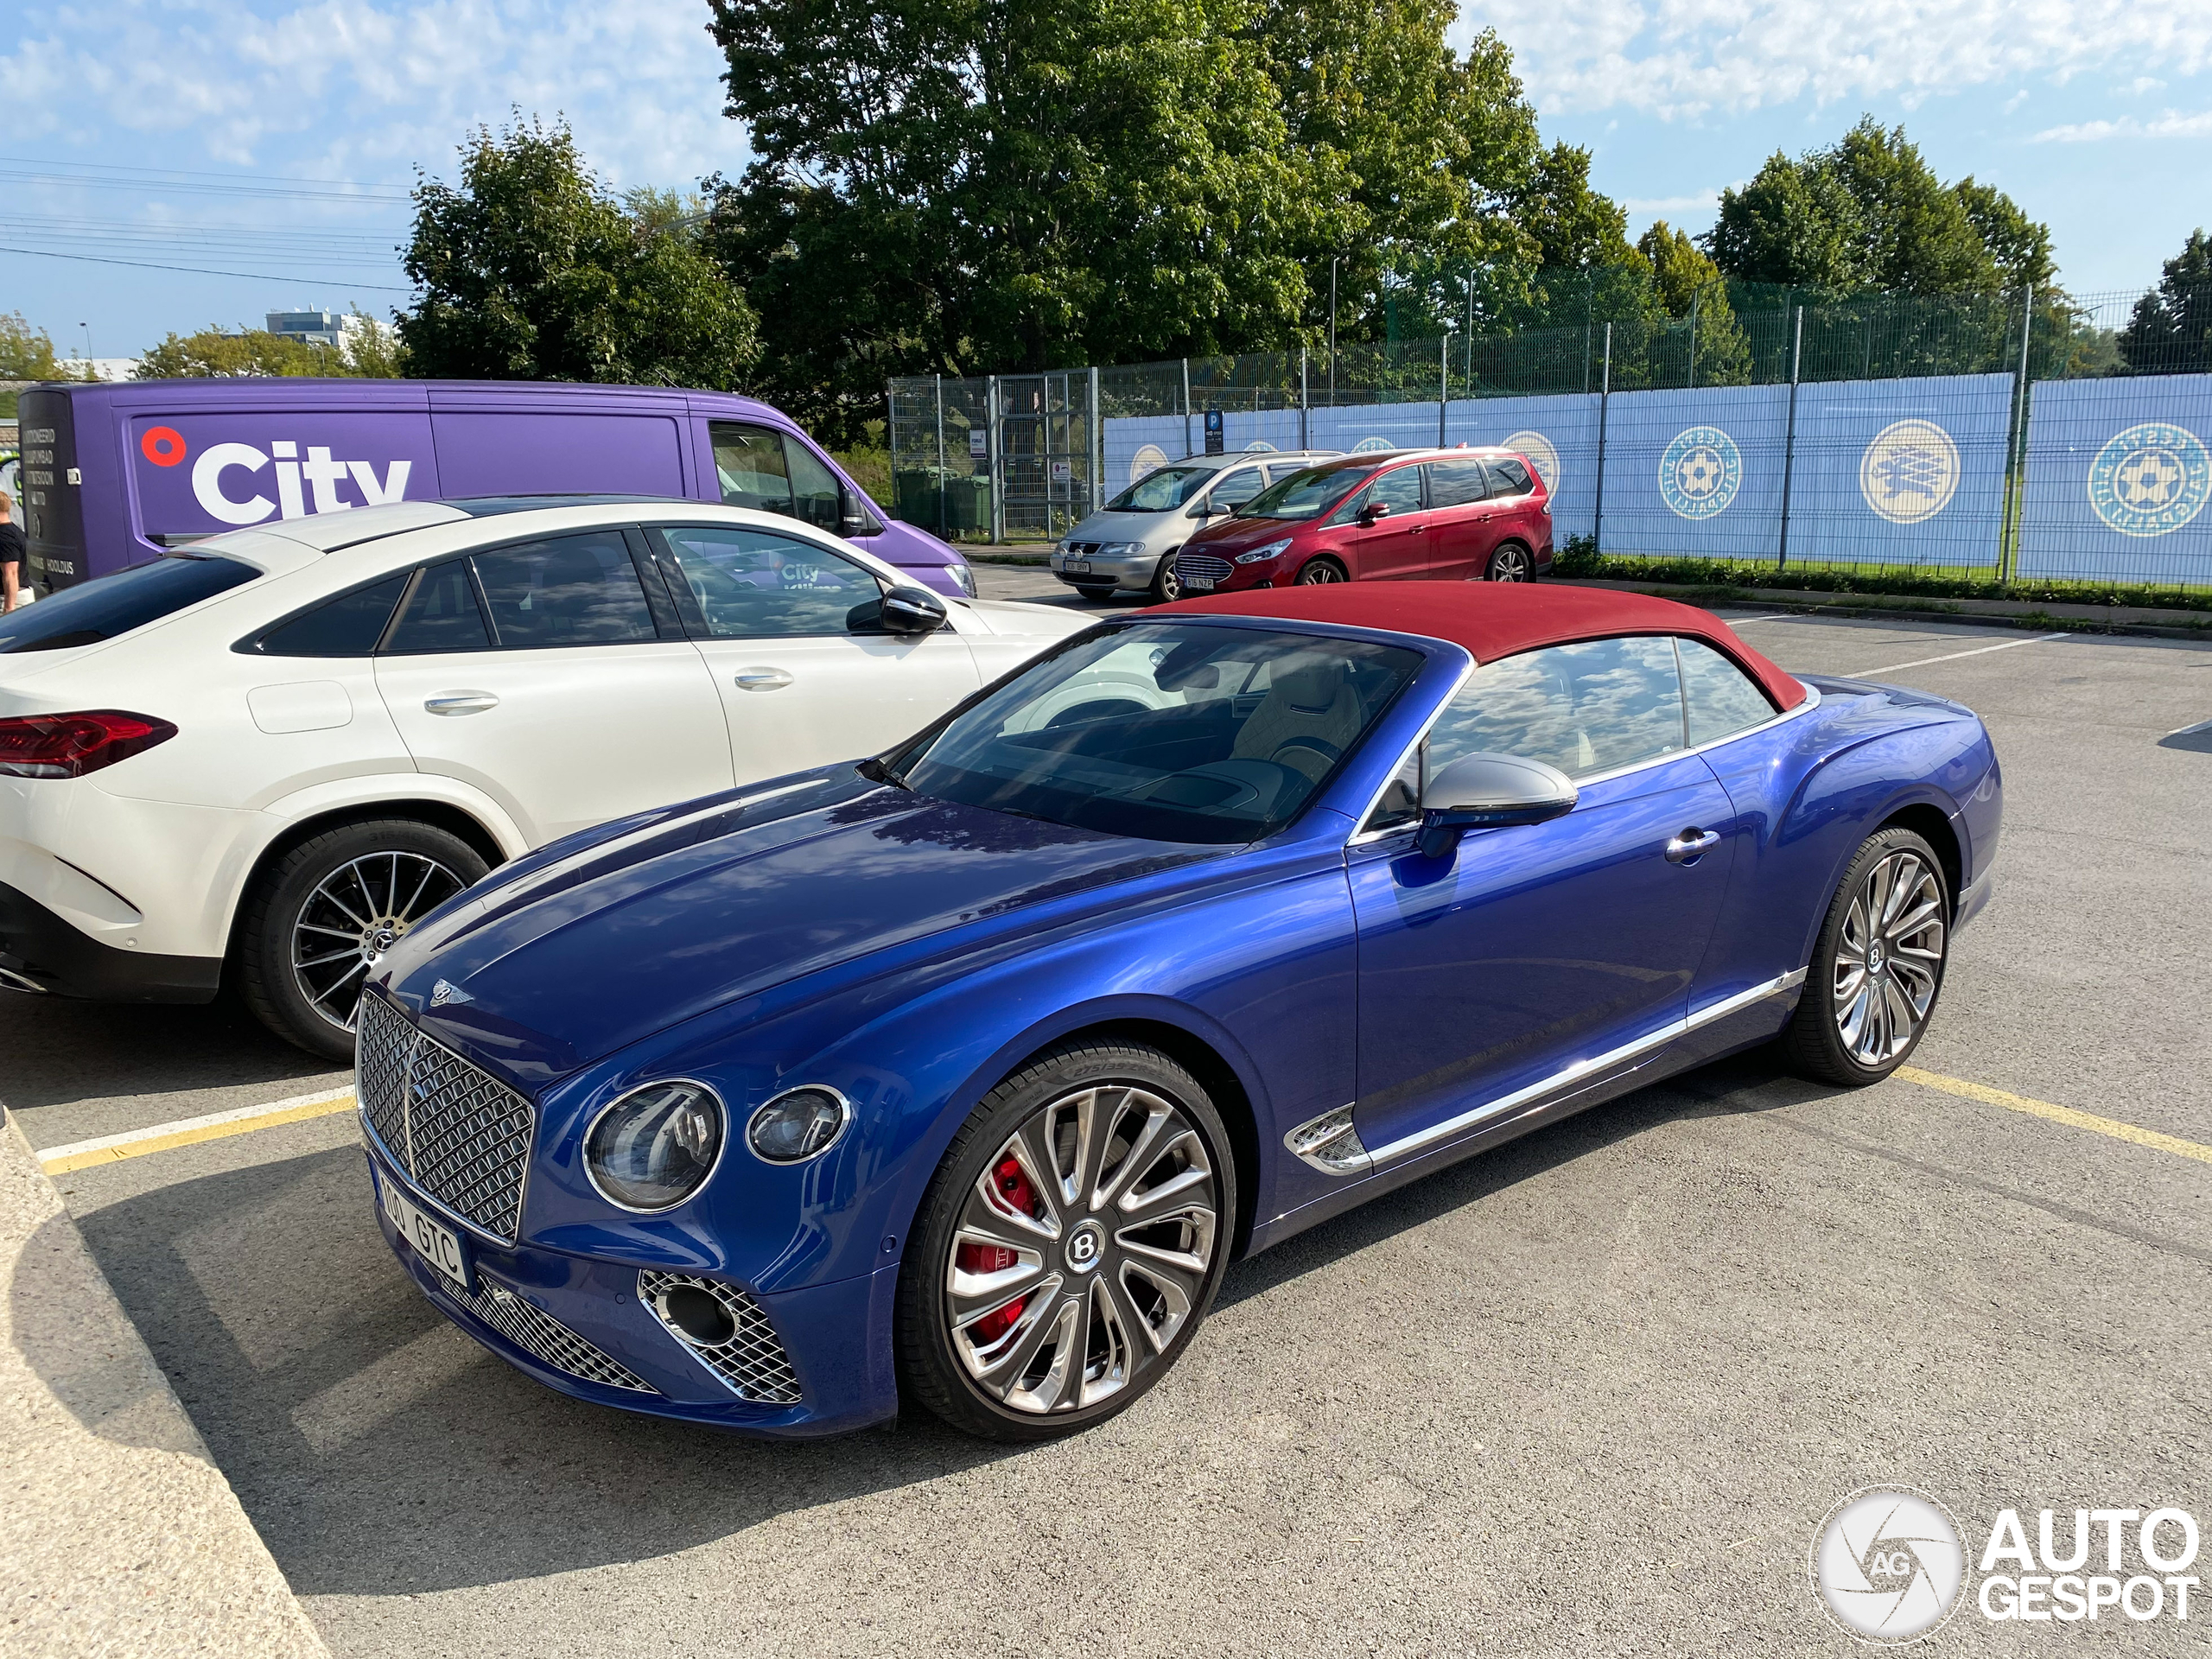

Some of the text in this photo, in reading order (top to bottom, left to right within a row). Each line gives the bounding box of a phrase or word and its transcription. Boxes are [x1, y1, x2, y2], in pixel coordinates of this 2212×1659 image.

[192, 441, 412, 524] City
[781, 563, 820, 582] City
[1198, 579, 1212, 588] NZP
[415, 1213, 458, 1274] GTC
[1073, 1233, 1095, 1259] B
